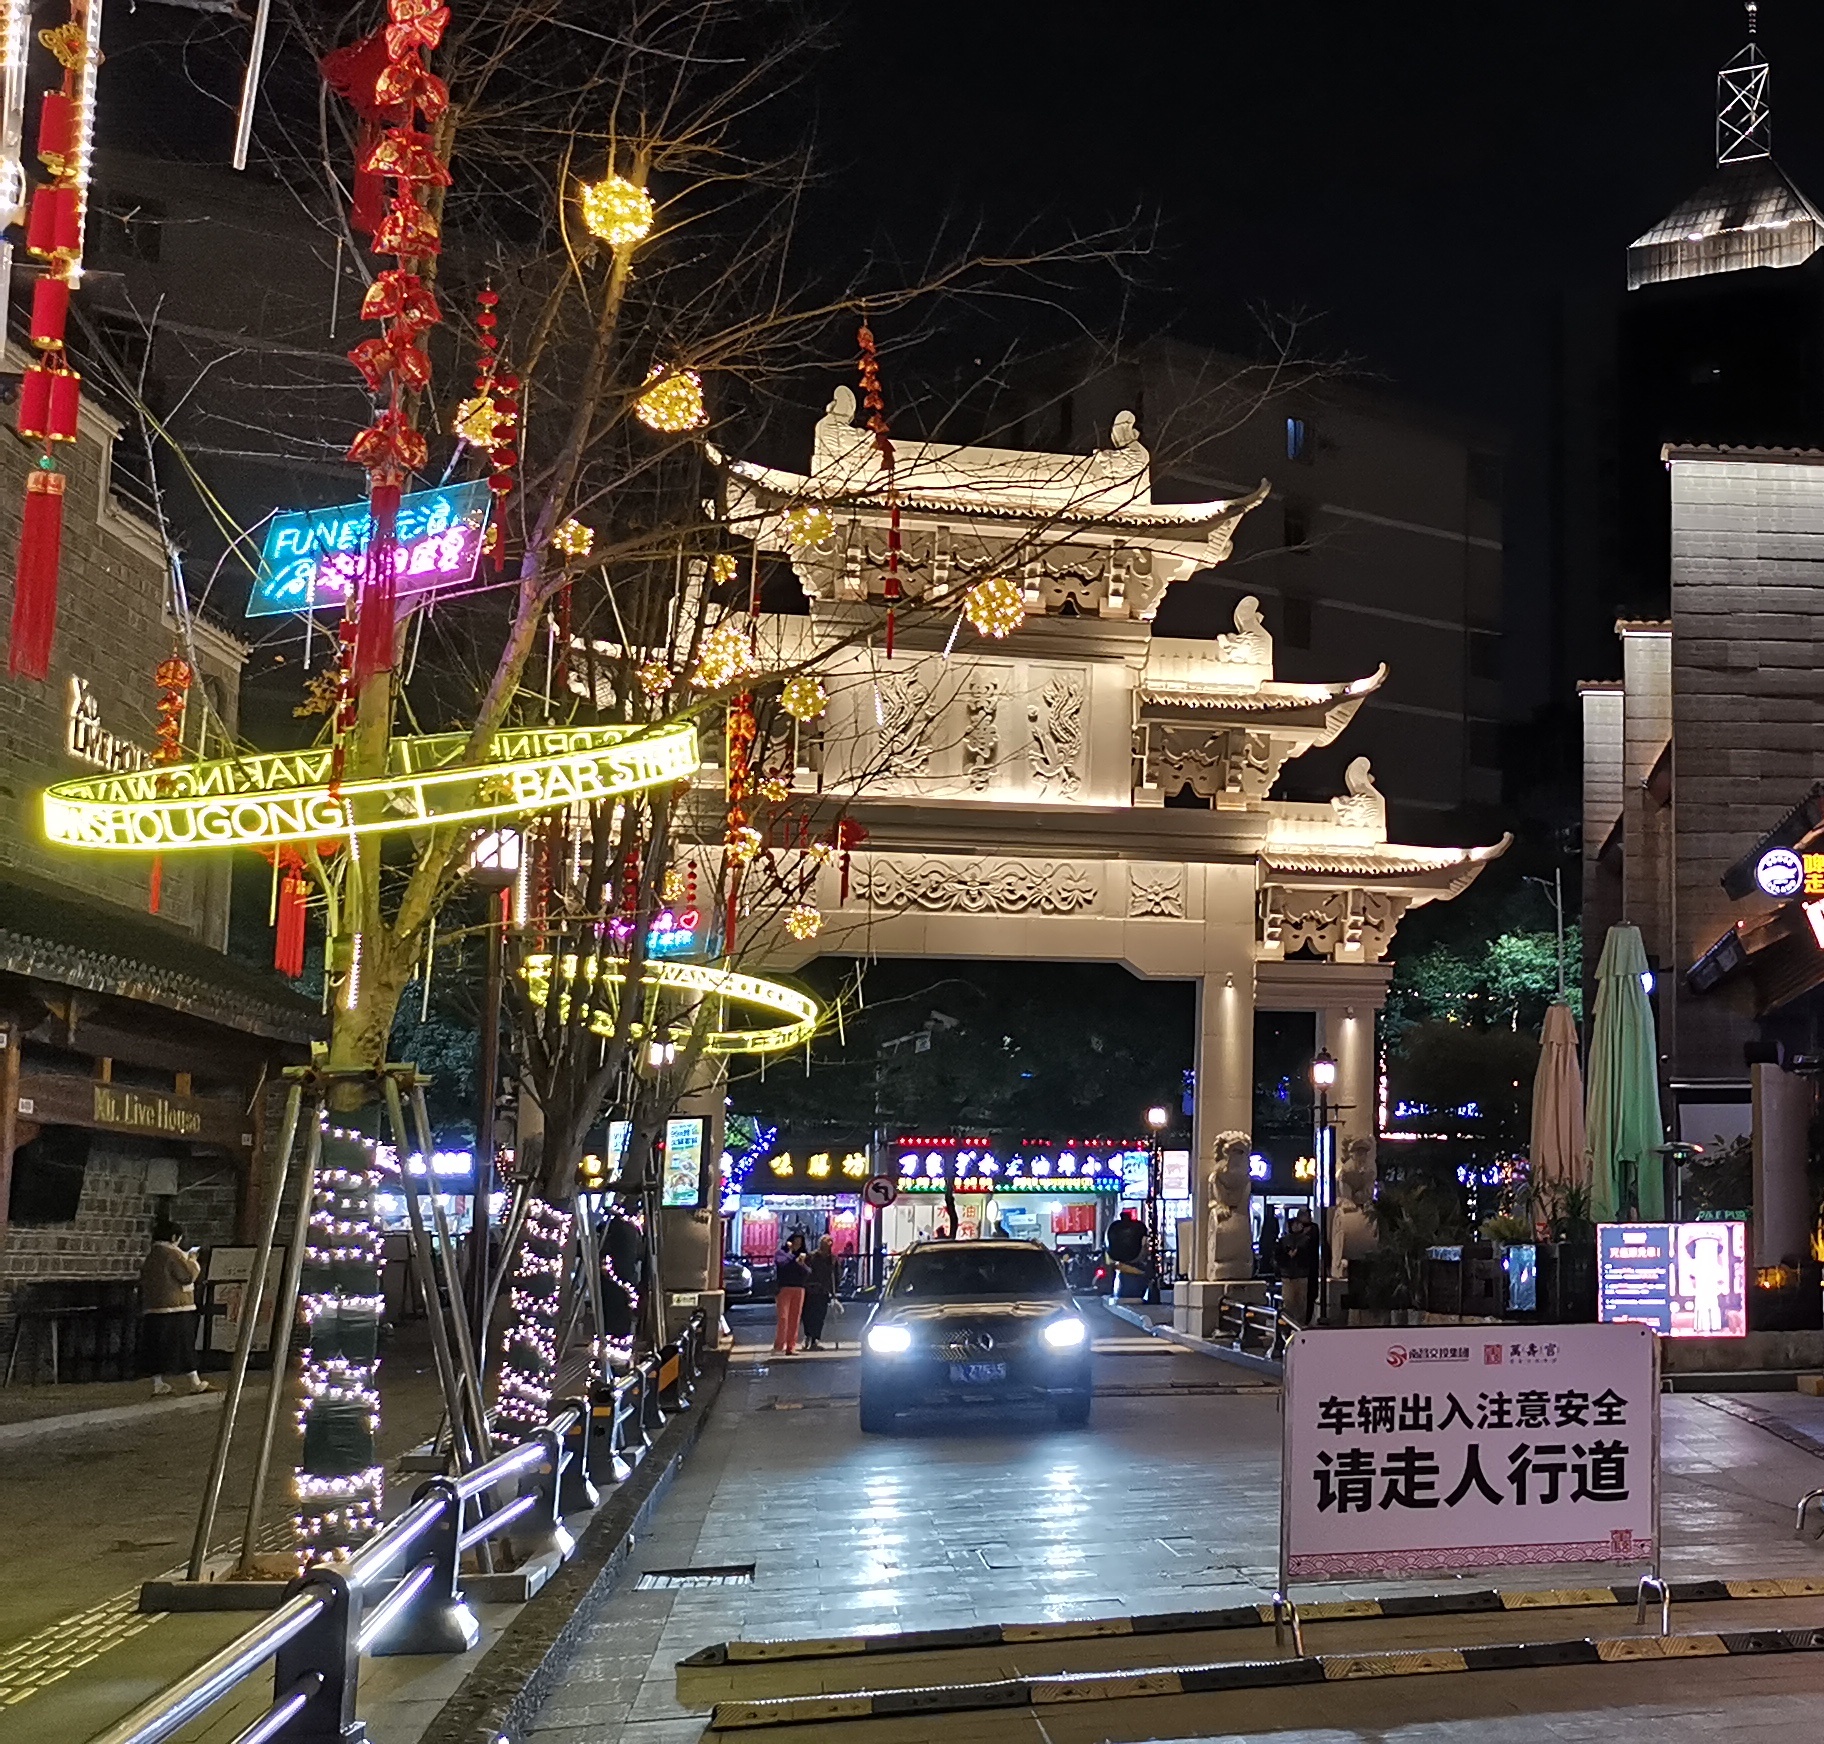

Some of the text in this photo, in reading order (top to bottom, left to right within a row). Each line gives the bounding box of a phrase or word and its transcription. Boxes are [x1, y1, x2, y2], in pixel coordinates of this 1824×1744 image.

[512, 758, 602, 804] BAR
[125, 1093, 155, 1127] Live
[1316, 1387, 1629, 1435] 车辆出入注意安全
[1312, 1439, 1630, 1514] 请走人行道
